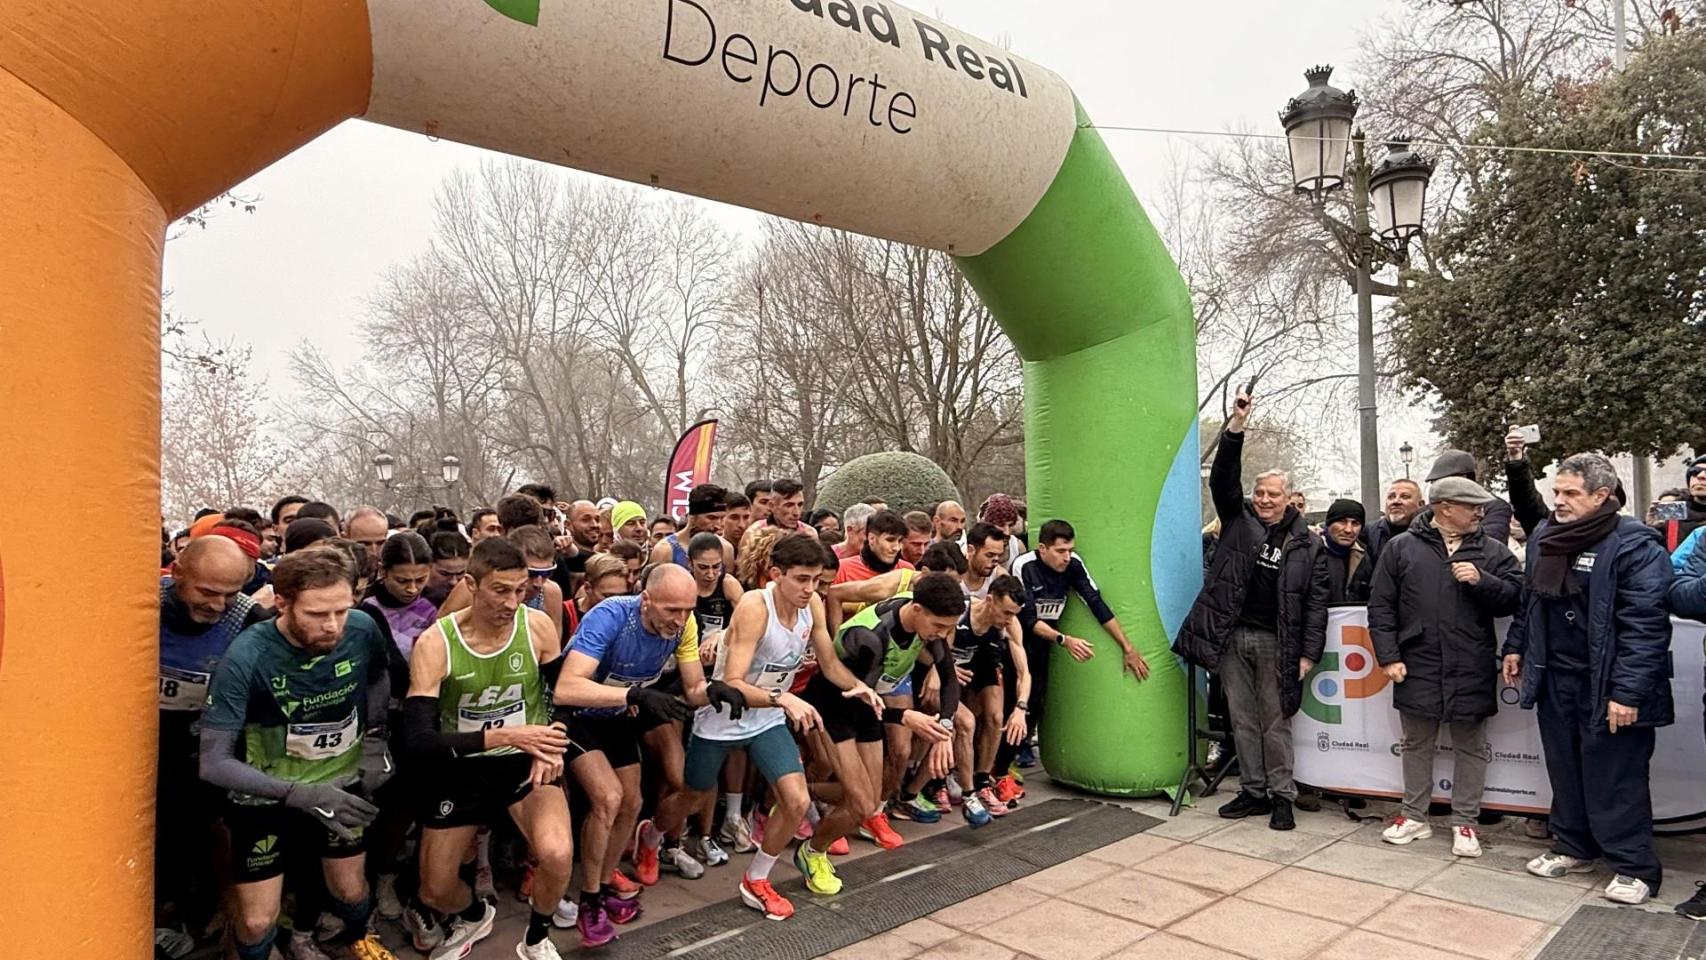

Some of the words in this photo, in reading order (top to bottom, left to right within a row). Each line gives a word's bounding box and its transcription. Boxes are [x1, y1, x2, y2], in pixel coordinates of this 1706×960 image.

[664, 0, 916, 134] Deporte
[912, 18, 1028, 98] Real
[776, 672, 789, 683] 3
[457, 683, 522, 708] LEA
[312, 732, 343, 749] 43
[1495, 751, 1520, 759] Ciudad
